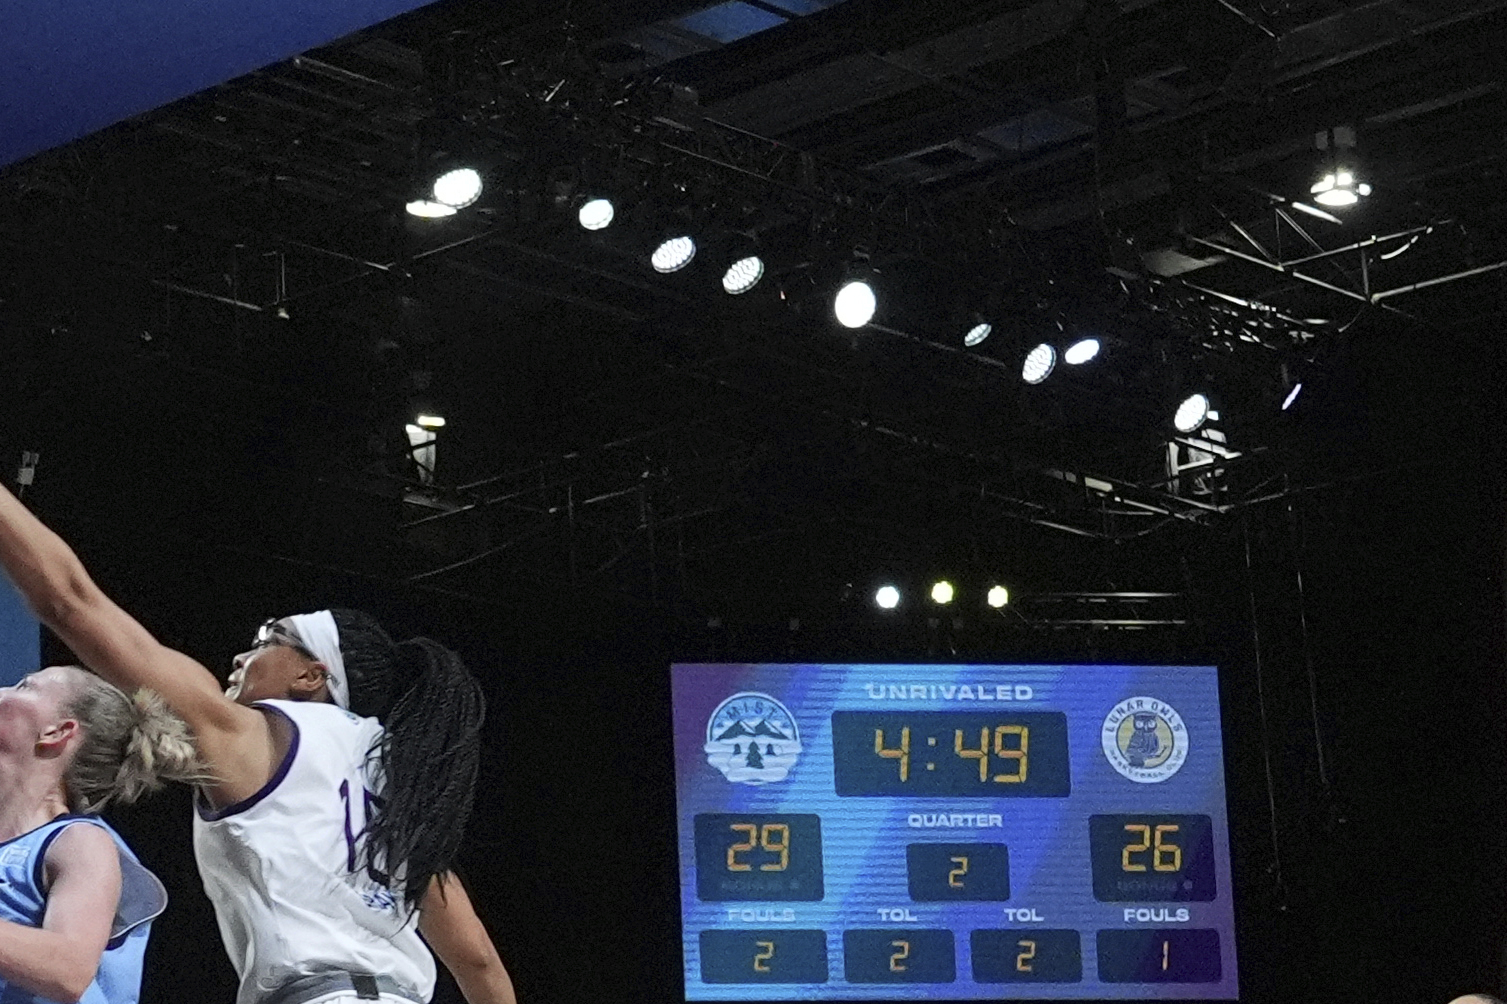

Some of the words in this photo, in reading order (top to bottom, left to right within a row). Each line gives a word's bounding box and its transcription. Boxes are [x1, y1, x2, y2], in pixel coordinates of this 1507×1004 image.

[867, 684, 1034, 700] UNRIVALED
[725, 701, 778, 720] MIST
[1105, 699, 1144, 733] LUNAR
[1151, 701, 1183, 732] OWLS
[875, 726, 1029, 782] 4:49
[907, 813, 1003, 828] QUARTER
[727, 824, 789, 871] 29
[1121, 825, 1181, 871] 26
[948, 856, 968, 888] 2
[727, 908, 796, 923] FOULS
[877, 908, 918, 922] TOL
[1003, 908, 1044, 922] TOL
[1123, 908, 1190, 922] FOULS
[754, 941, 774, 972] 2
[889, 941, 909, 971] 2
[1016, 941, 1036, 971] 2
[1161, 941, 1170, 971] 1
